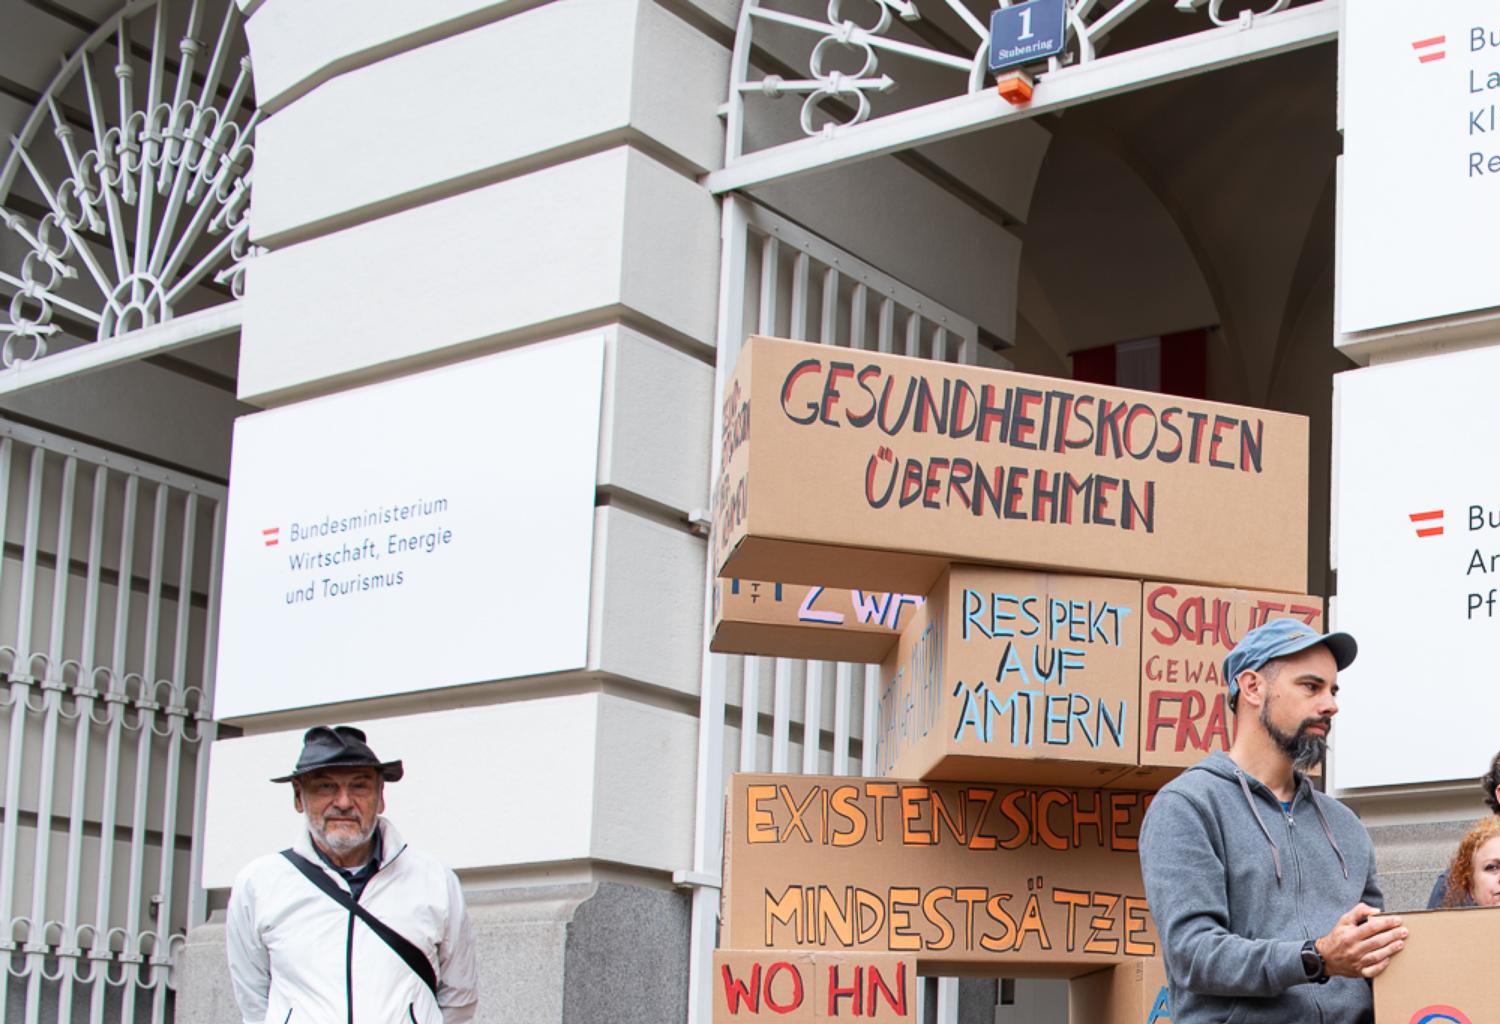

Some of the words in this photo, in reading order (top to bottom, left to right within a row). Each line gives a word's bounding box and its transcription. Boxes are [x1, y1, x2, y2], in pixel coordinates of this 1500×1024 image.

[998, 39, 1054, 60] Stubenring
[1017, 7, 1034, 40] 1
[780, 358, 1264, 474] GESUNDHEITSKOSTEN
[865, 447, 1155, 533] ÜBERNEHMEN
[290, 498, 448, 543] Bundesministerium
[289, 537, 380, 571] Wirtschaft,
[387, 526, 452, 555] Energie
[285, 581, 315, 605] und
[321, 570, 404, 598] Tourismus
[962, 588, 1132, 647] RESPEKT
[998, 646, 1086, 687] AUF
[1145, 655, 1228, 687] GEWA
[953, 681, 1127, 750] ÄMTERN
[1146, 690, 1238, 752] FRA
[746, 782, 1153, 852] EXISTENZSICHE
[764, 876, 1156, 957] MINDESTSÄTZE
